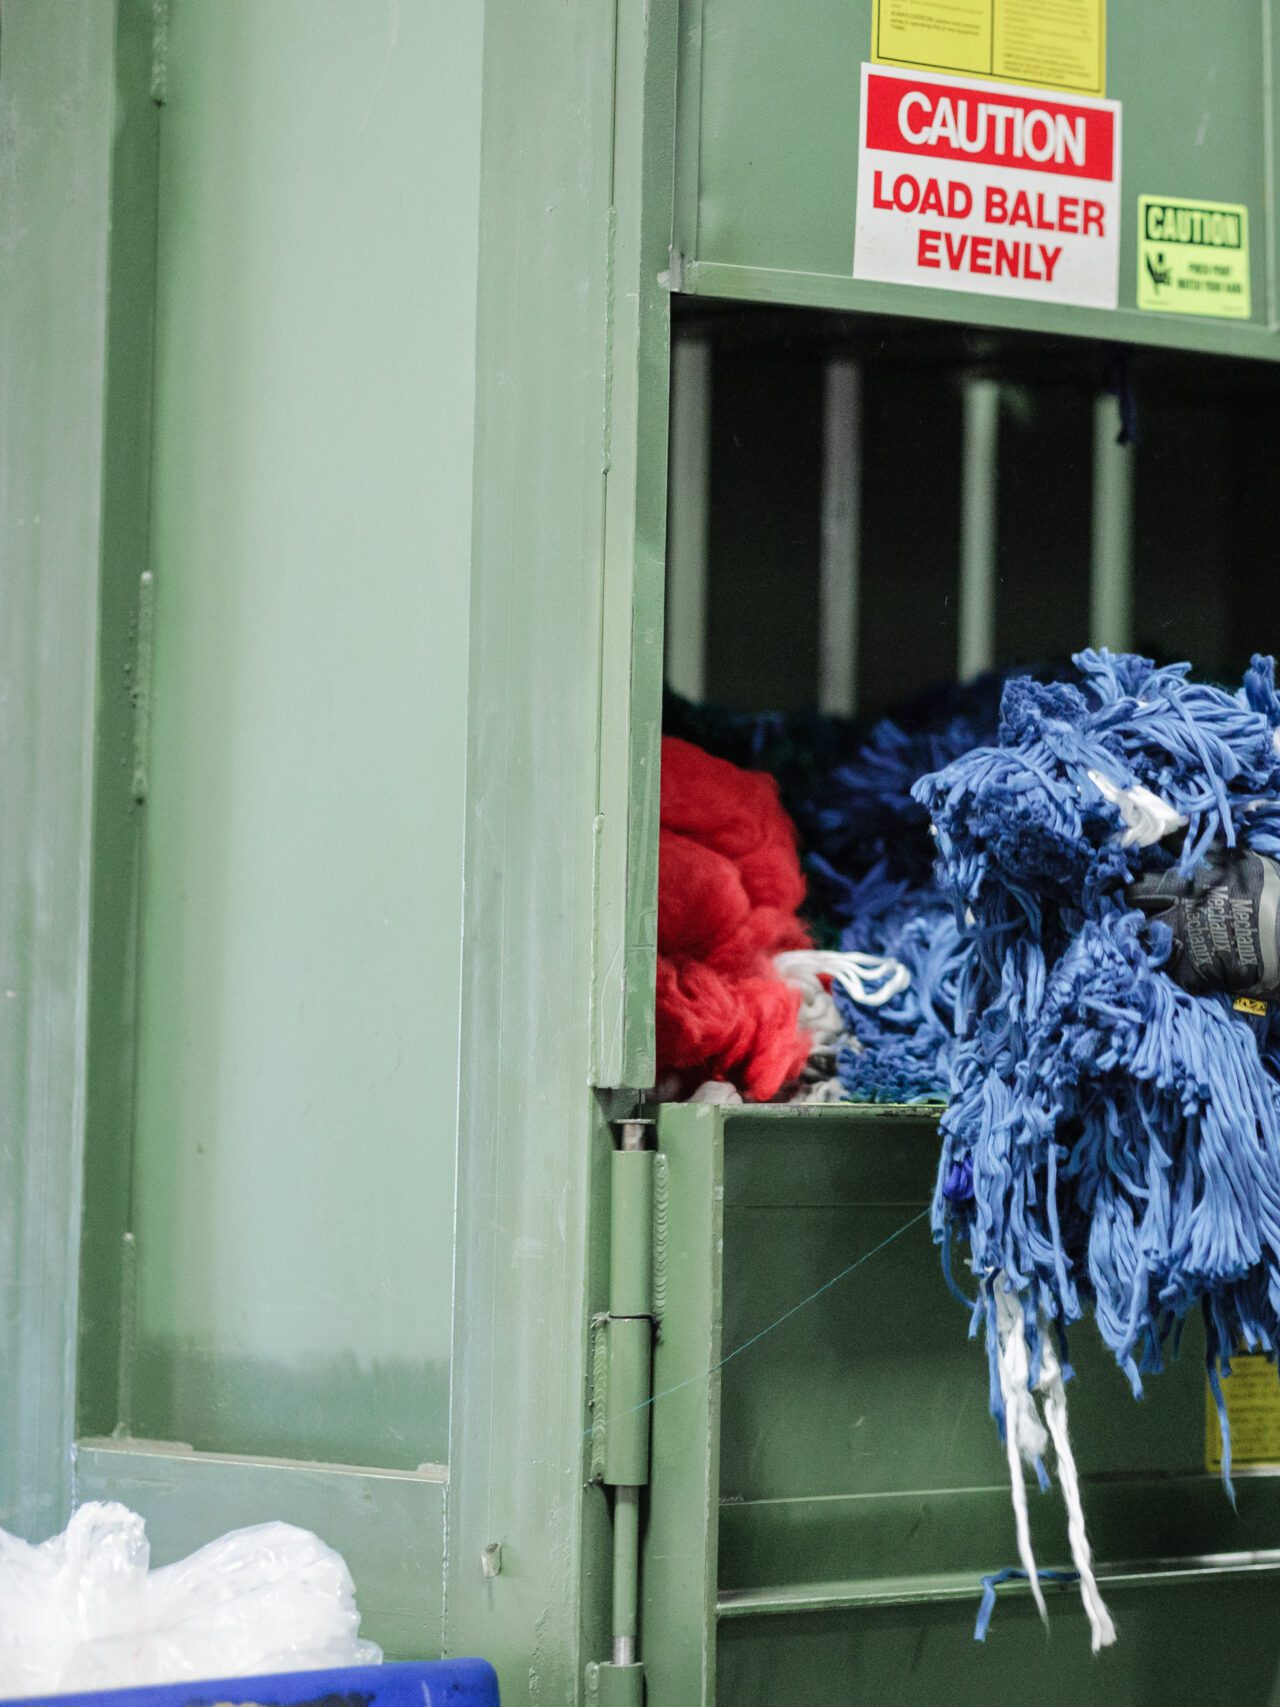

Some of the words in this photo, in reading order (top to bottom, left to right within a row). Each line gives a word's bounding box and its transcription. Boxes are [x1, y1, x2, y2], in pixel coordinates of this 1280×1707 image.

[897, 91, 1086, 166] CAUTION
[873, 170, 973, 219] LOAD
[984, 186, 1106, 238] BALER
[1148, 206, 1238, 246] CAUTION
[917, 228, 1063, 282] EVENLY
[1206, 886, 1233, 952] Mechanix
[1232, 899, 1258, 965] Mechanix
